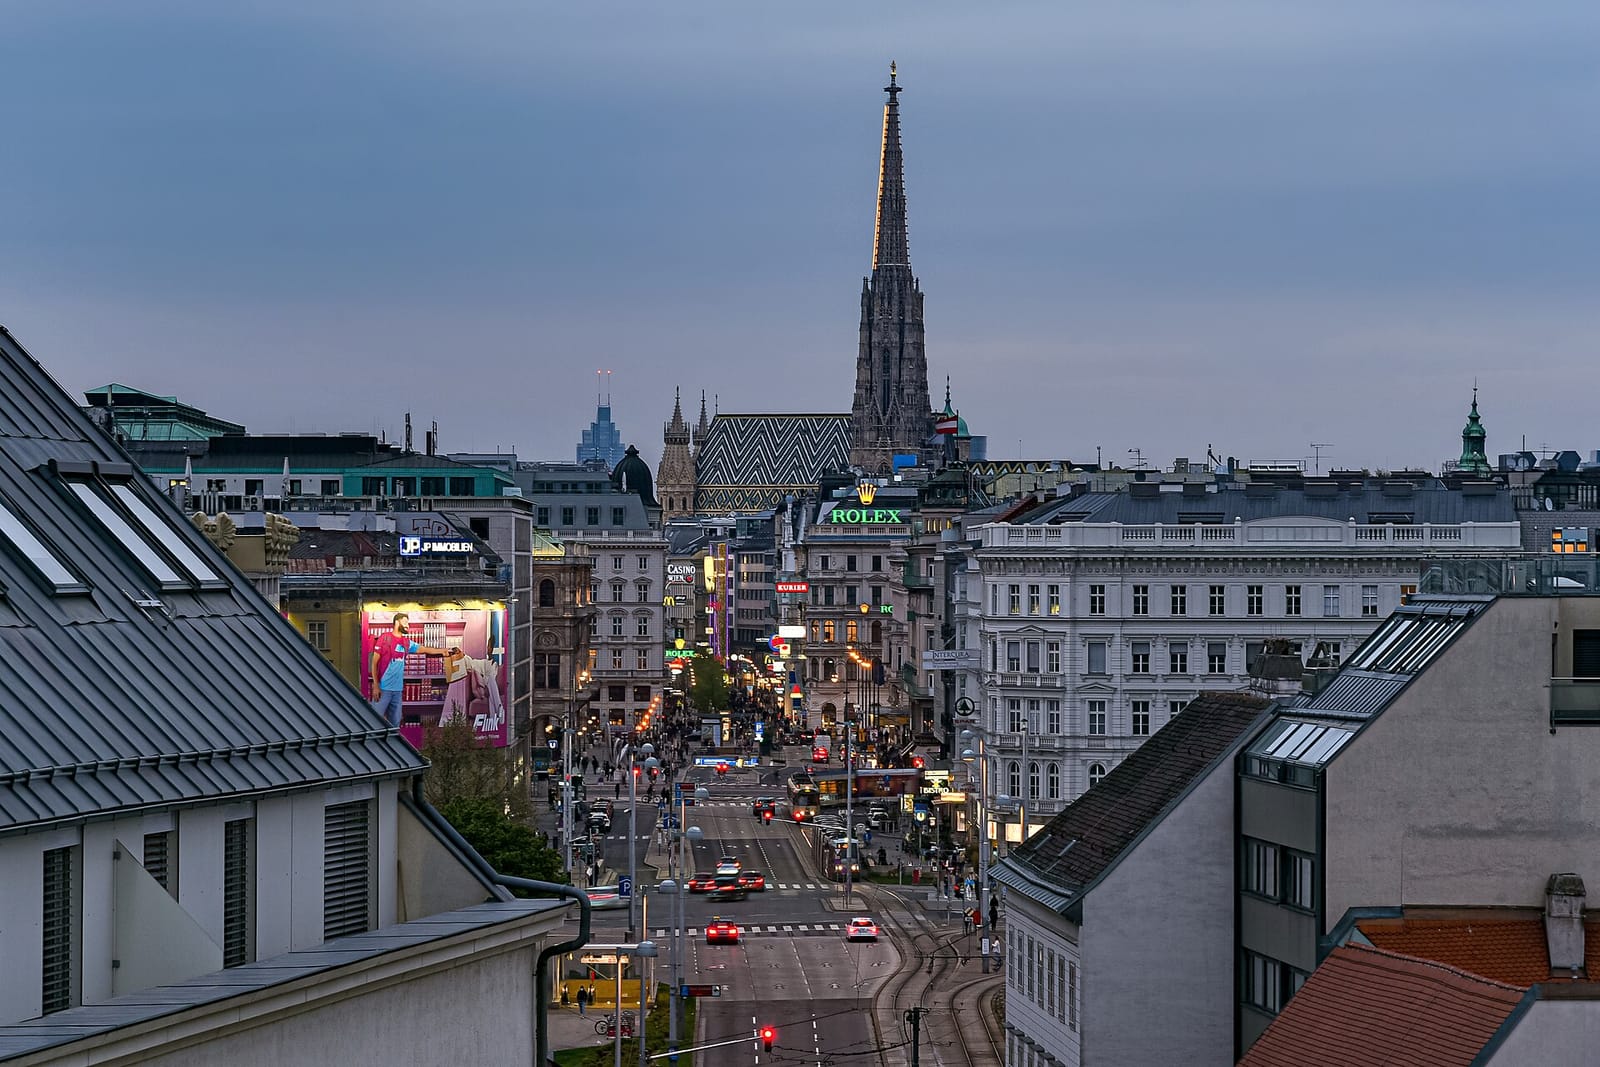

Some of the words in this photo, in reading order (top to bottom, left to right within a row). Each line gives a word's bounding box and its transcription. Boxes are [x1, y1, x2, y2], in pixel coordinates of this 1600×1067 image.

[831, 509, 902, 524] ROLEX
[402, 539, 420, 553] JP
[421, 542, 431, 552] JP
[431, 542, 473, 552] IMMOBILIEN
[472, 713, 499, 732] Flink
[623, 881, 631, 892] P
